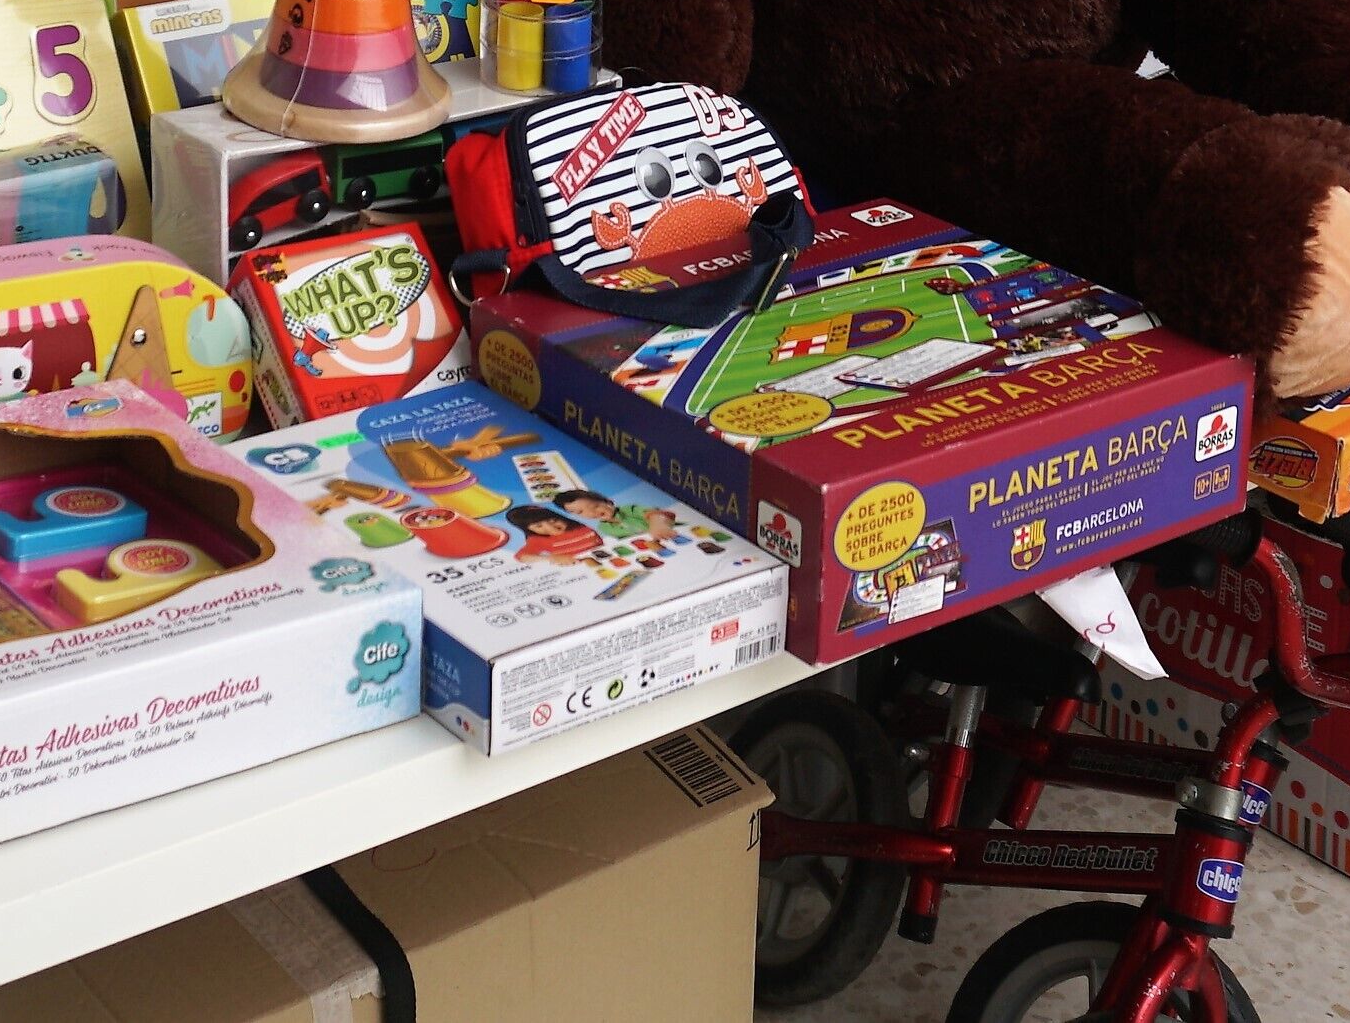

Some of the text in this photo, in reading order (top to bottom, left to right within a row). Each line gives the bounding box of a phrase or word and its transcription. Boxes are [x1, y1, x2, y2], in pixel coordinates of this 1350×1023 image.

[150, 8, 224, 35] minions
[36, 24, 95, 118] 5
[557, 96, 643, 199] PLAY TIME
[284, 246, 430, 324] WHAT'S
[332, 294, 399, 341] UP?
[369, 412, 413, 428] CAZA
[434, 395, 476, 412] TAZA
[833, 375, 1038, 451] PLANETA
[1030, 340, 1165, 392] BARÇA
[563, 399, 662, 473] PLANETA
[668, 457, 740, 518] BARÇA
[1197, 429, 1235, 454] BORRAS
[968, 417, 1189, 514] PLANETA BARÇA
[858, 491, 915, 520] DE 2500
[1056, 497, 1145, 542] FCBARCELONA
[758, 526, 801, 560] BORRAS
[845, 531, 884, 553] SOBRE
[851, 535, 908, 564] EL BARÇA
[1055, 515, 1143, 555] www.fcbarcelona.cat
[425, 555, 506, 585] 35 PCS
[43, 616, 157, 656] Adhesivas
[157, 581, 284, 623] Decorativas
[361, 641, 400, 667] Cife
[355, 685, 403, 711] design
[34, 712, 141, 761] Adhesivas
[145, 675, 262, 726] Decorativas
[983, 838, 1049, 867] Chicco
